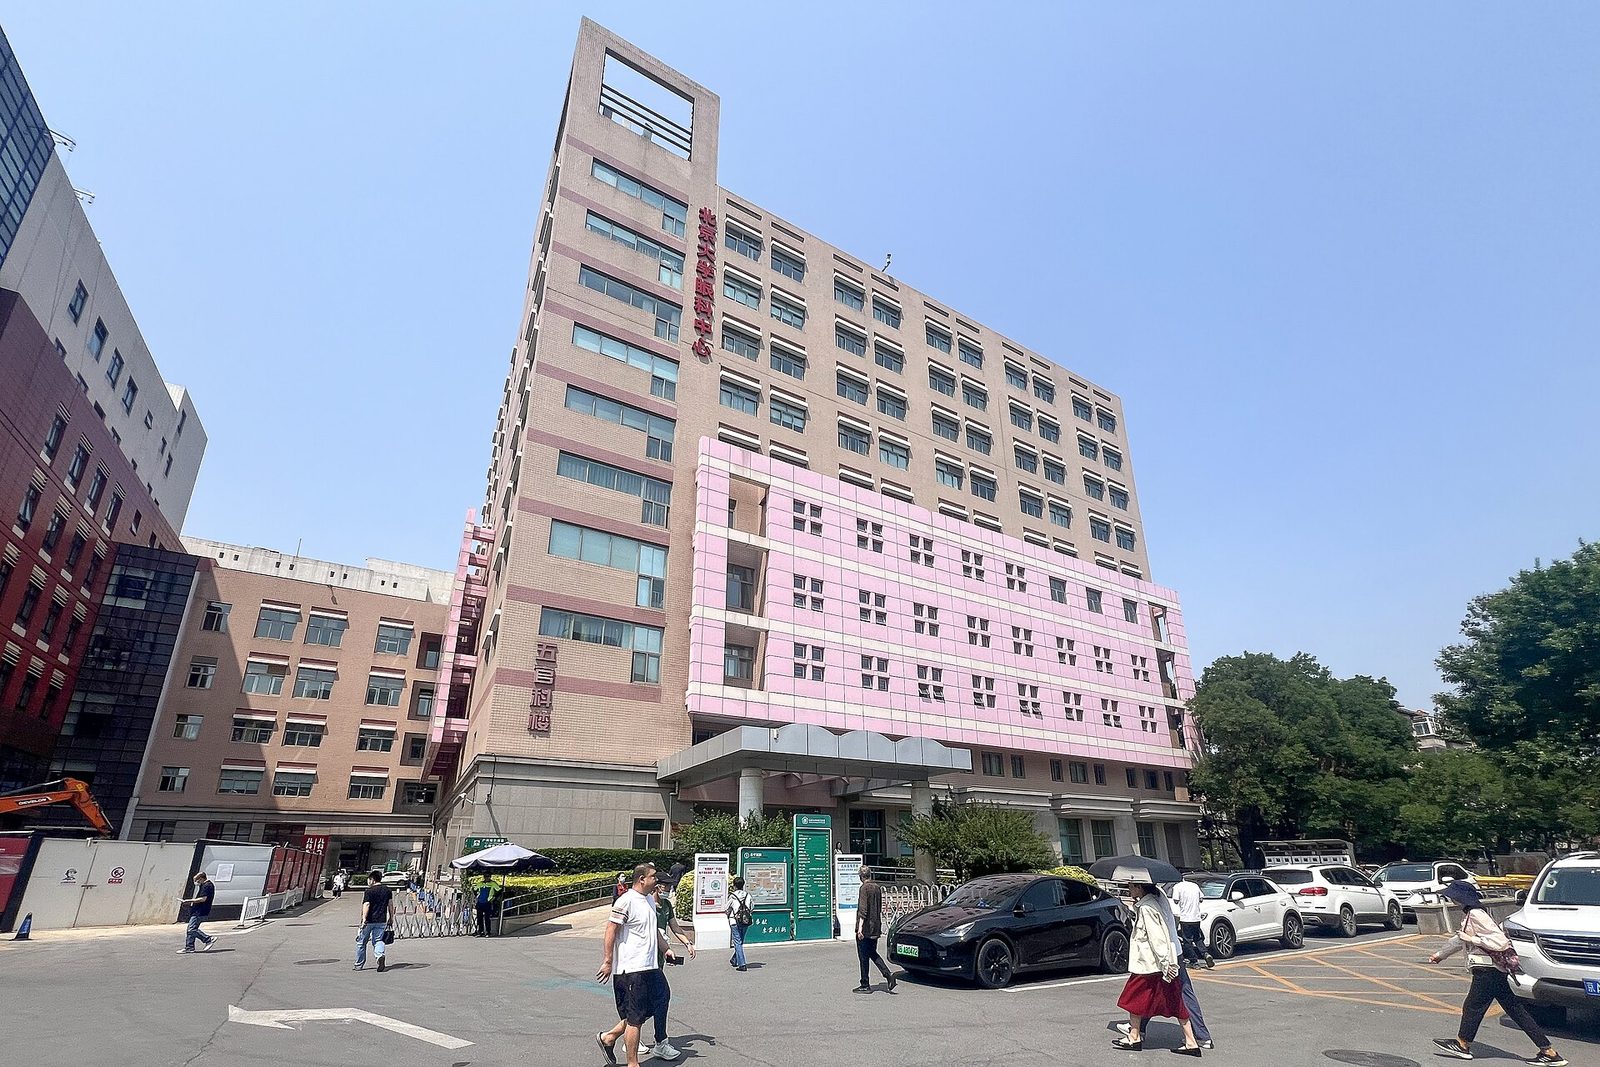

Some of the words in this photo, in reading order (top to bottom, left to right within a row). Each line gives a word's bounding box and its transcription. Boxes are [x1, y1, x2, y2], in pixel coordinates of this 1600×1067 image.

[692, 207, 717, 358] 北京大学眼科中心
[527, 642, 559, 732] 五官科楼
